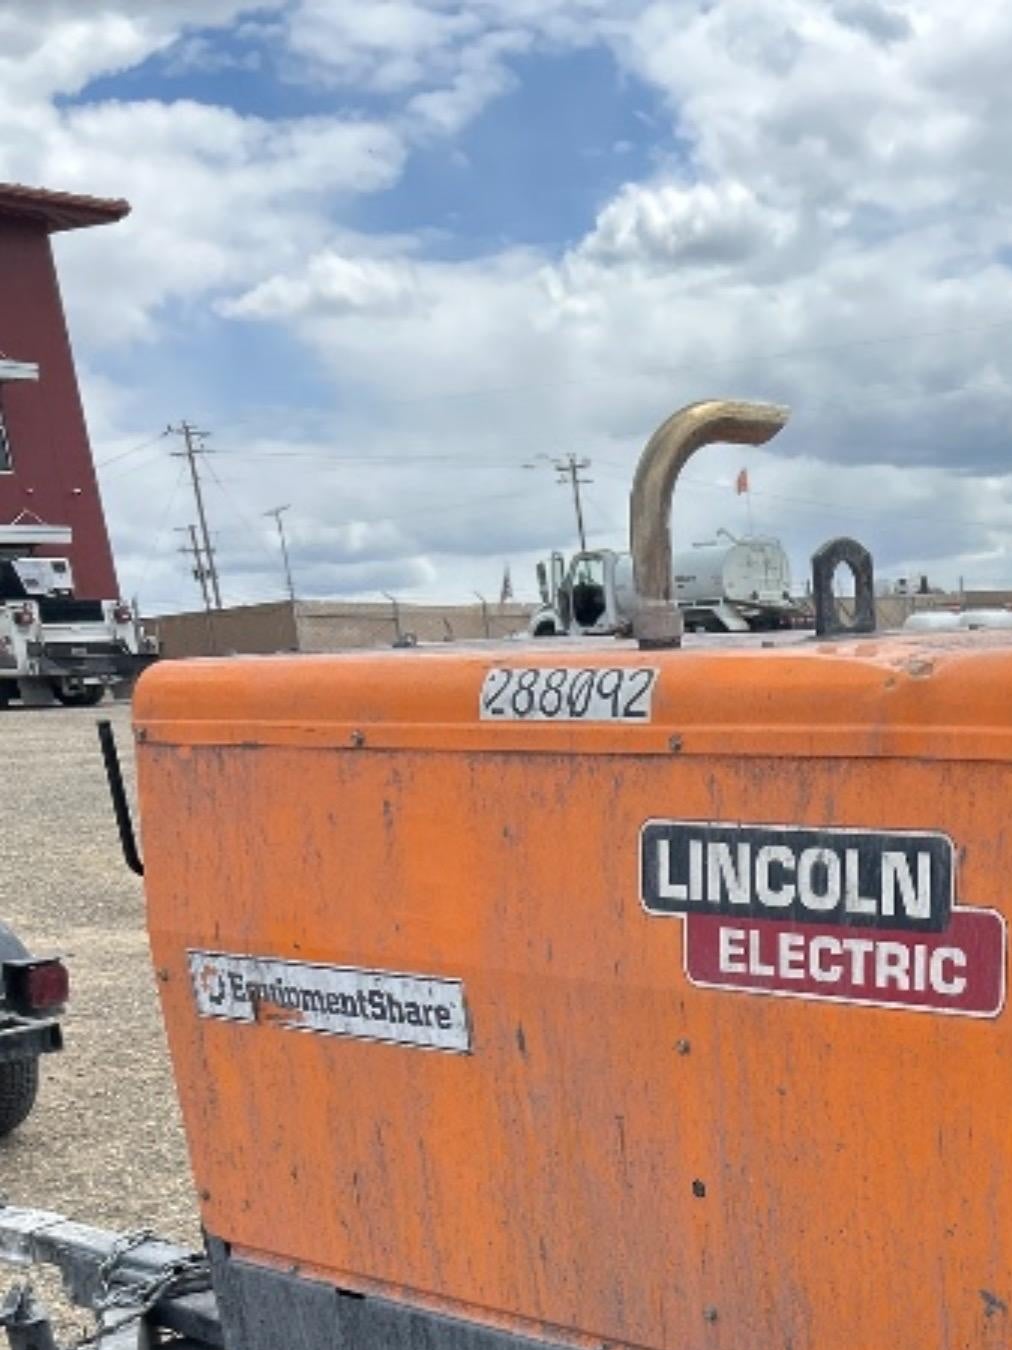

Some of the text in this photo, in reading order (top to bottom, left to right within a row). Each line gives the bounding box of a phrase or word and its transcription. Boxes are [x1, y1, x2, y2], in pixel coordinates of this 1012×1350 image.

[484, 669, 654, 718] 288092
[656, 839, 931, 920] LINCOLN
[718, 926, 967, 995] ELECTRIC
